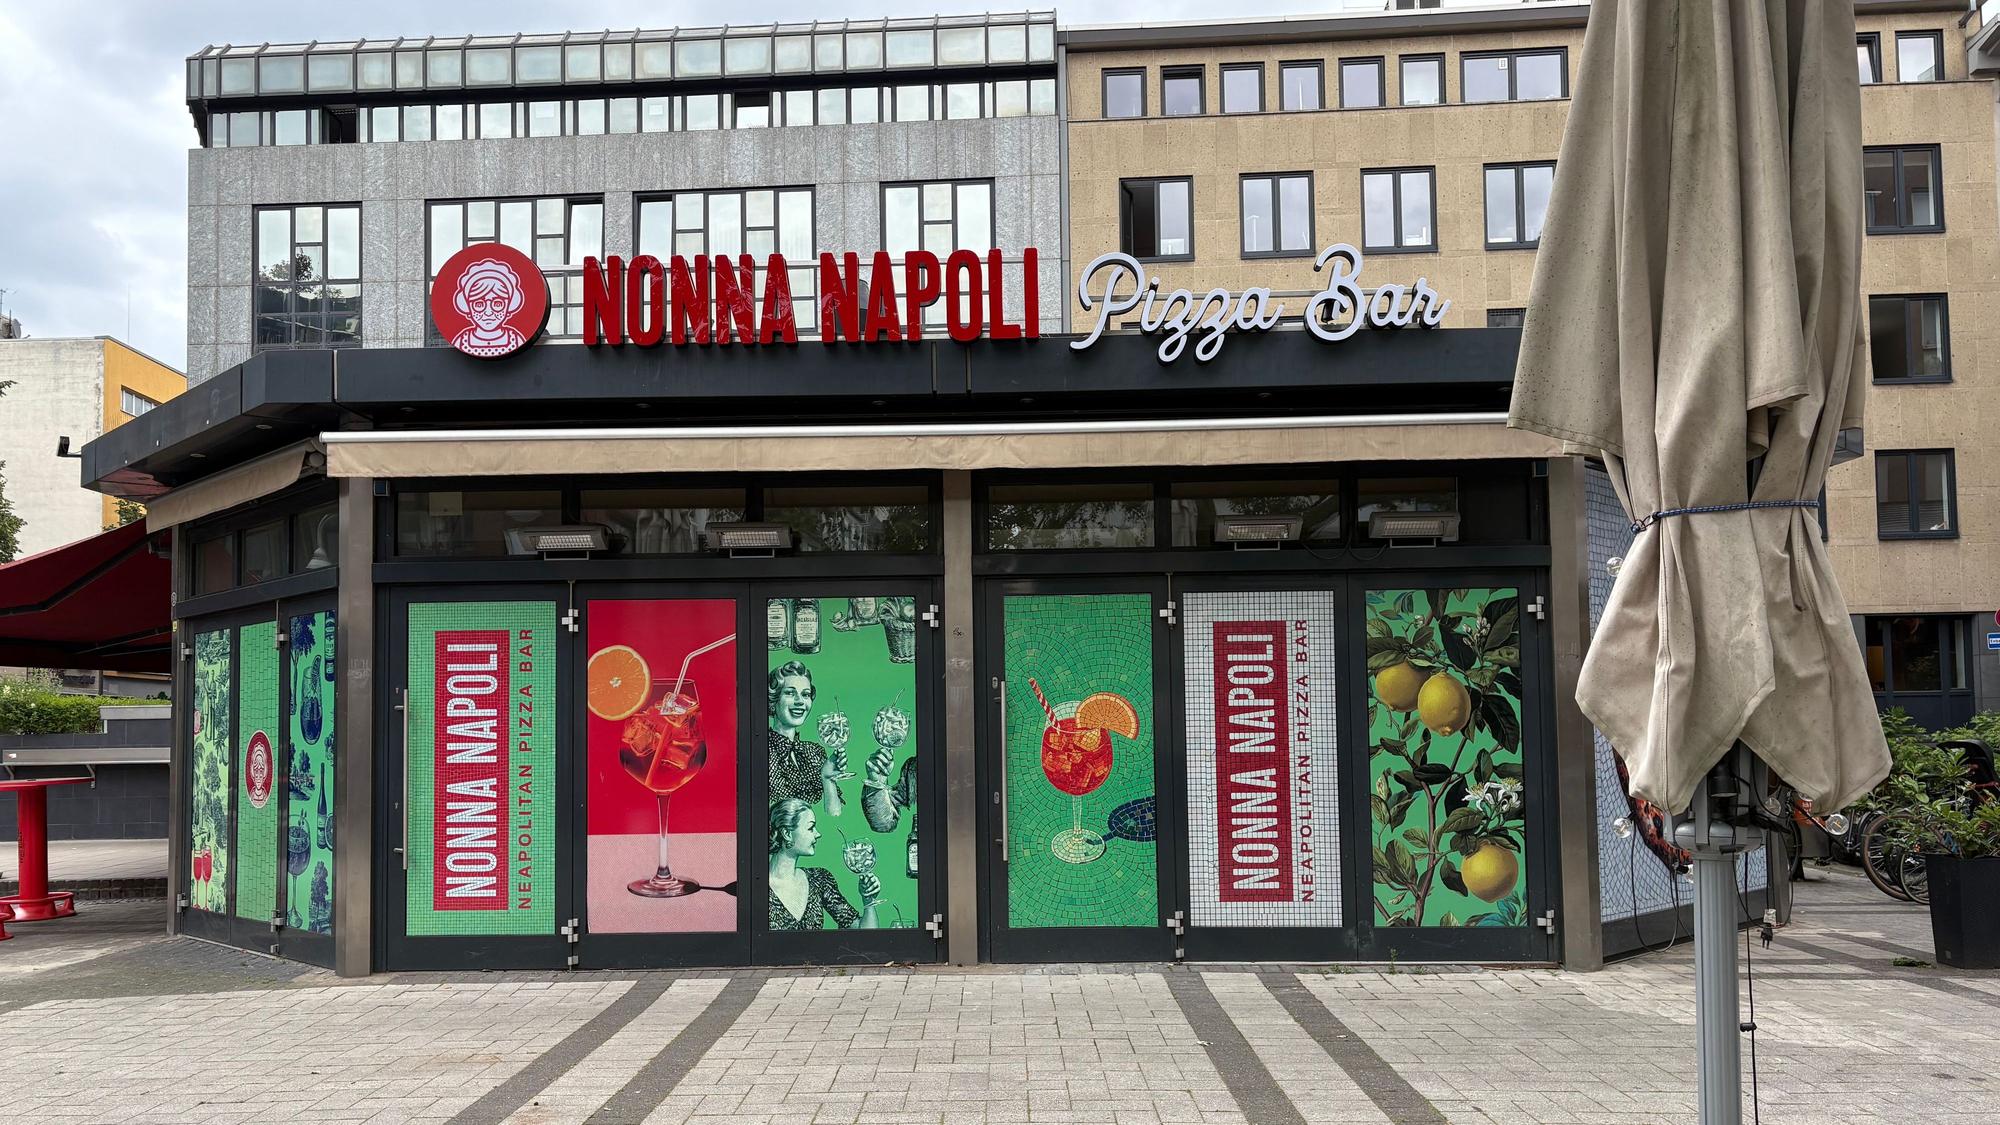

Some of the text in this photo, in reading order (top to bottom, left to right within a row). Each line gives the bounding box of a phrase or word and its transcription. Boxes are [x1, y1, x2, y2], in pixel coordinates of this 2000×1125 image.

[583, 247, 1039, 346] NONNA NAPOLI
[1069, 242, 1452, 364] Pizza Bar
[445, 643, 498, 897] NONNA NAPOLI
[518, 628, 534, 910] NEAPOLITAN PIZZA BAR
[1226, 634, 1280, 890] NONNA NAPOLI
[1295, 619, 1314, 902] NEAPOLITAN PIZZA BAR
